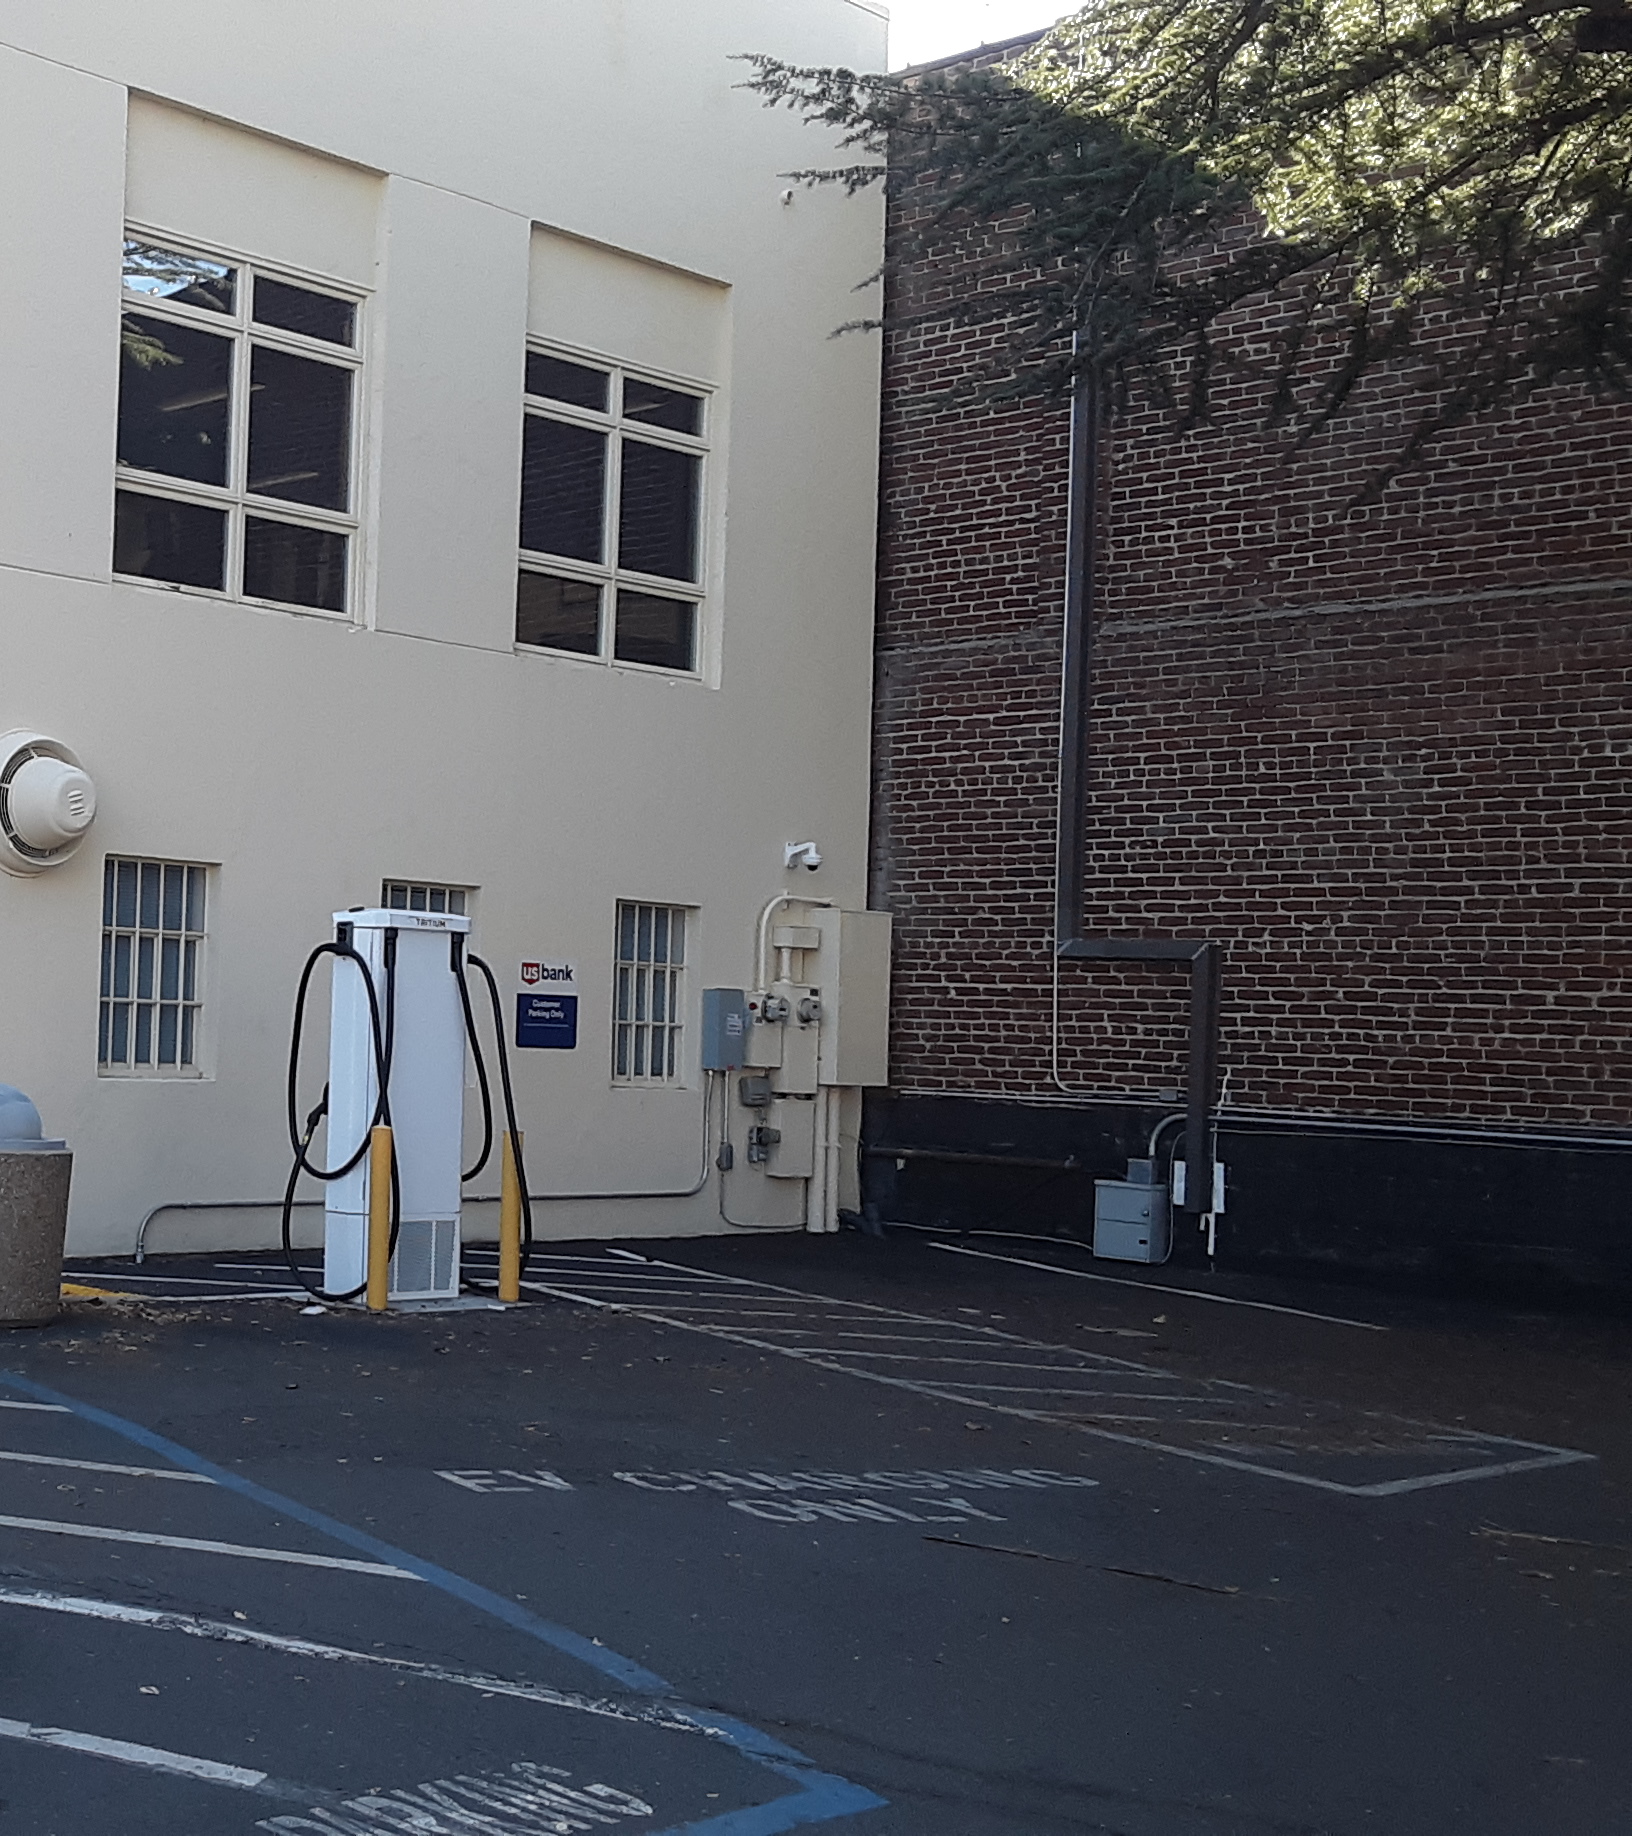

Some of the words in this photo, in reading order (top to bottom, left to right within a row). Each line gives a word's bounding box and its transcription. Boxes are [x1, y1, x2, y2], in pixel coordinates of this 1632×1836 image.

[523, 966, 539, 980] us
[541, 963, 574, 981] bank
[532, 999, 561, 1008] Customer
[527, 1009, 550, 1019] Parking
[550, 1010, 565, 1019] Only
[433, 1469, 578, 1492] EV
[612, 1469, 1100, 1491] CHARGING
[727, 1498, 1008, 1522] ONLY
